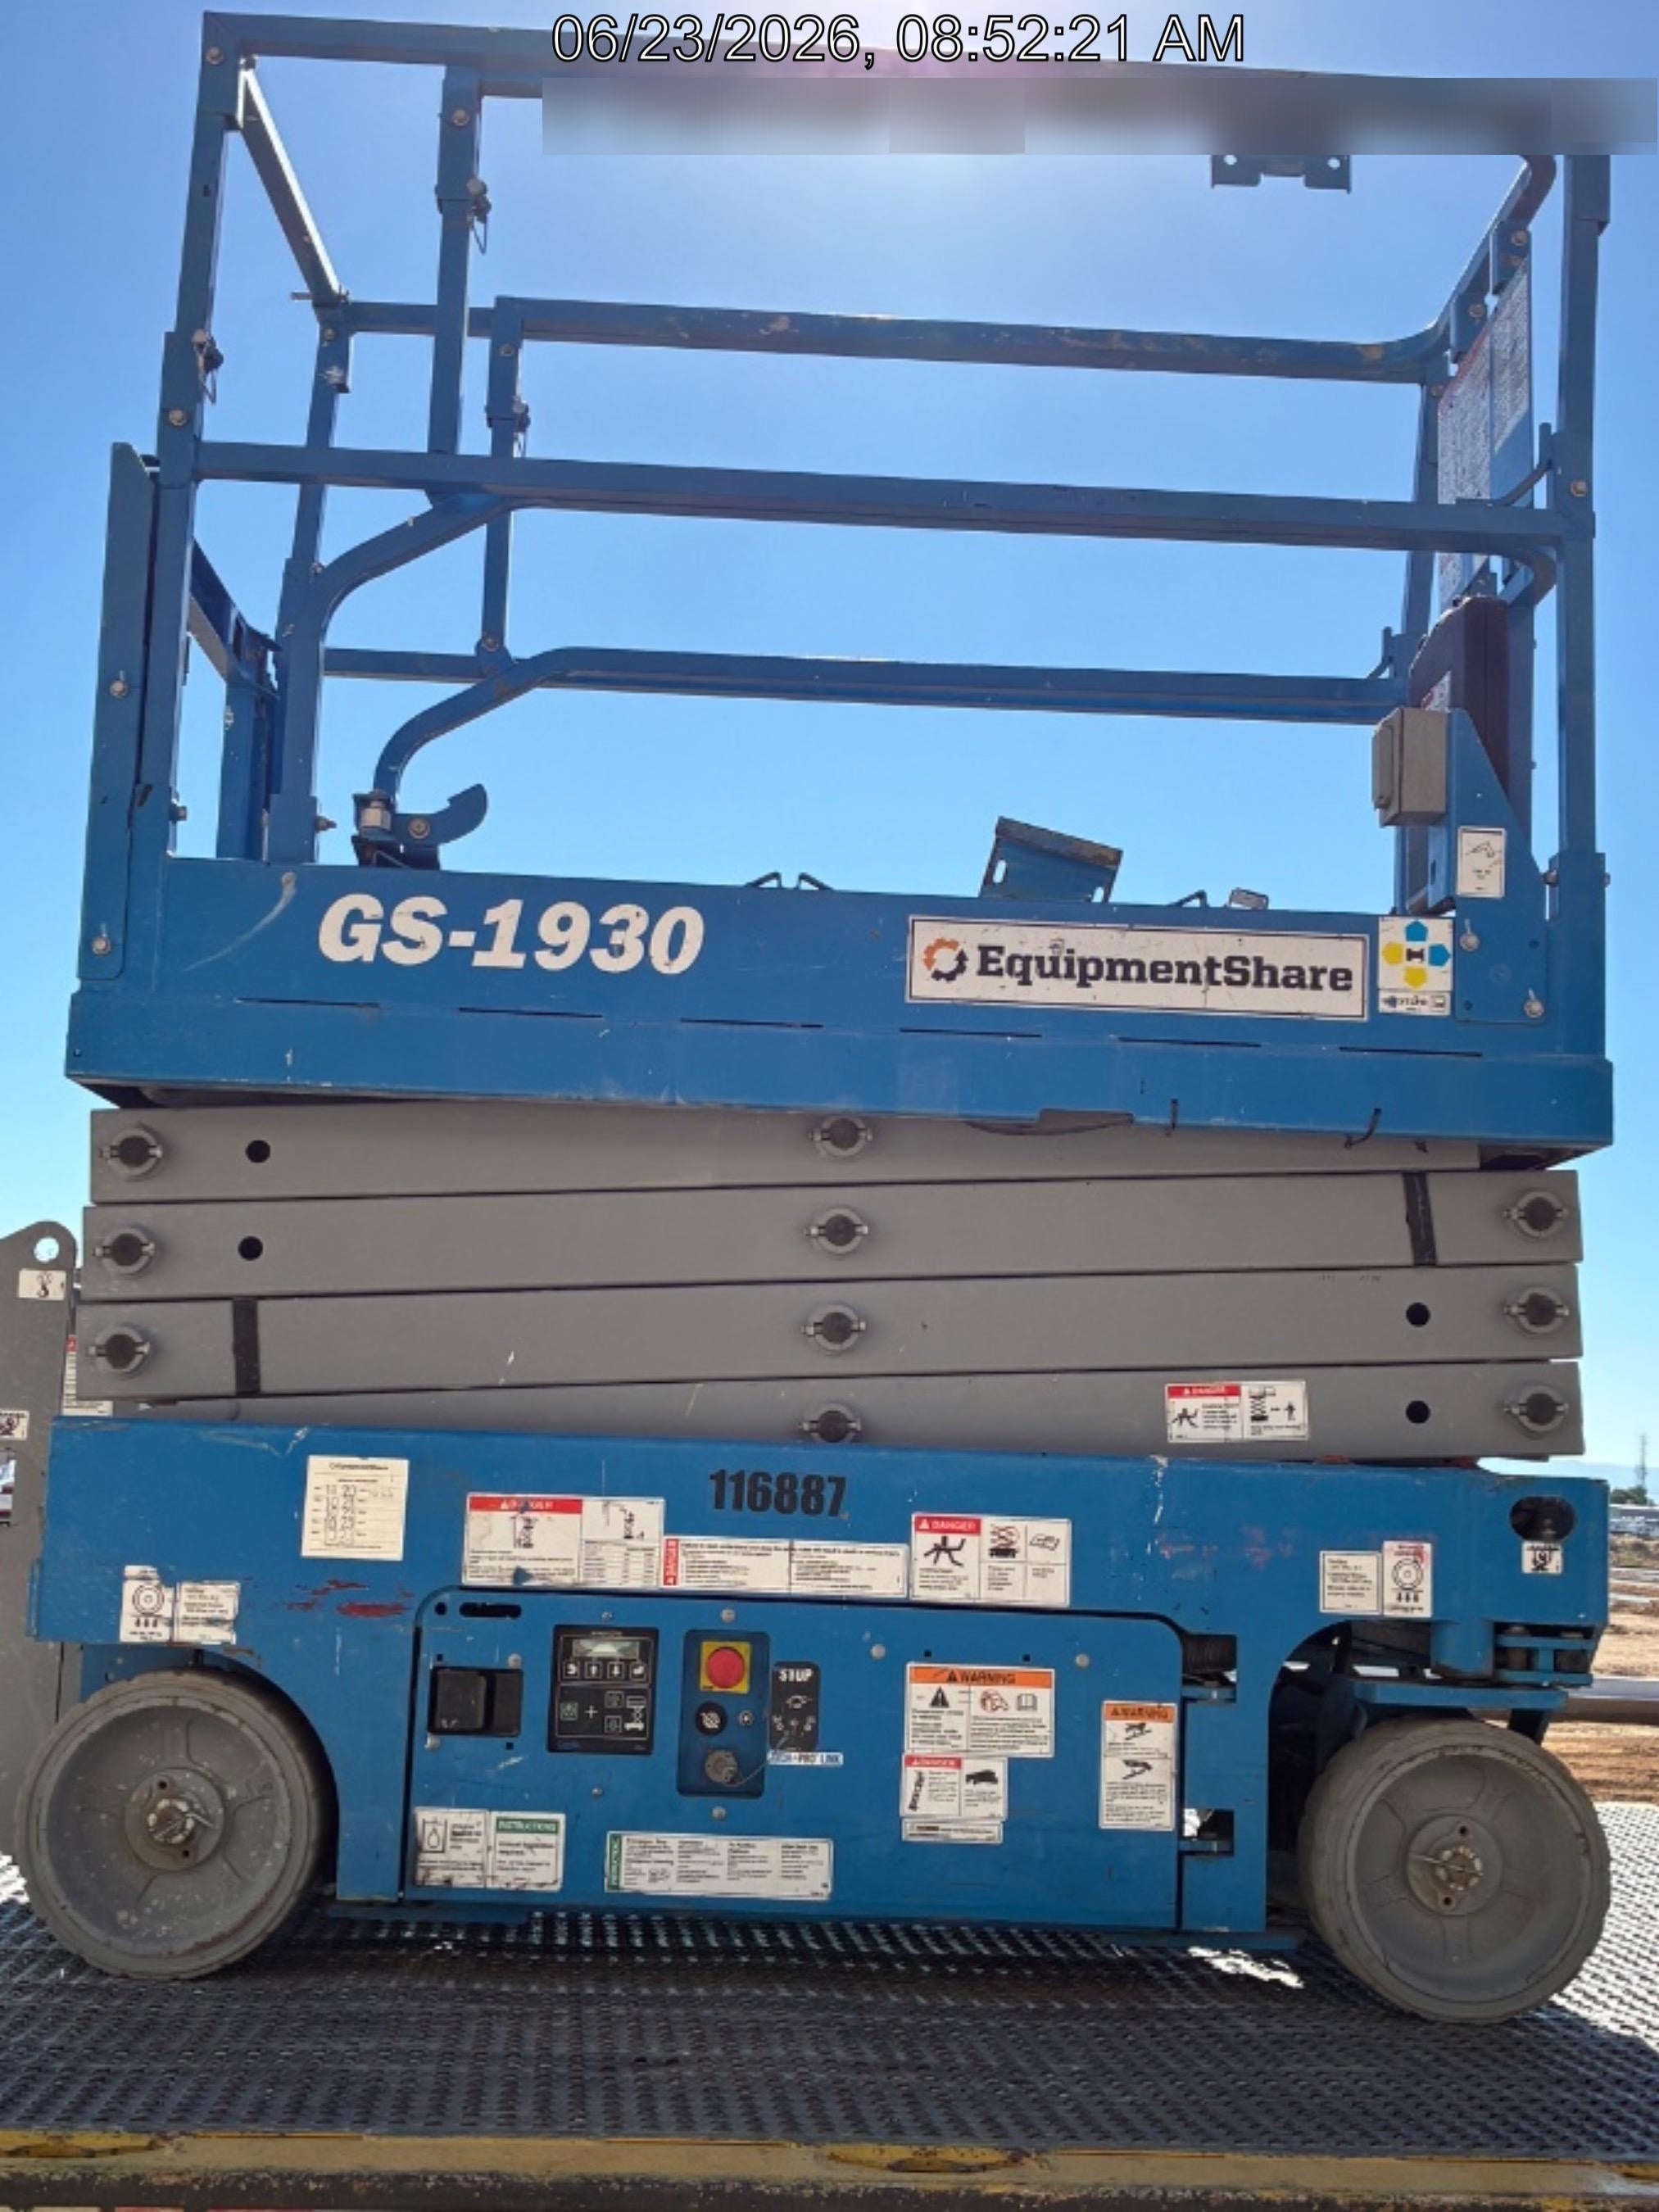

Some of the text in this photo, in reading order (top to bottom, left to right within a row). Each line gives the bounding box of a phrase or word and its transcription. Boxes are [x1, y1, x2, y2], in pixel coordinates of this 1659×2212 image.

[318, 893, 705, 975] GS-1930
[977, 945, 1353, 992] EquipmentShare
[709, 1469, 847, 1517] 116887
[931, 1521, 977, 1532] DANGER
[960, 1670, 1017, 1685] WARNING
